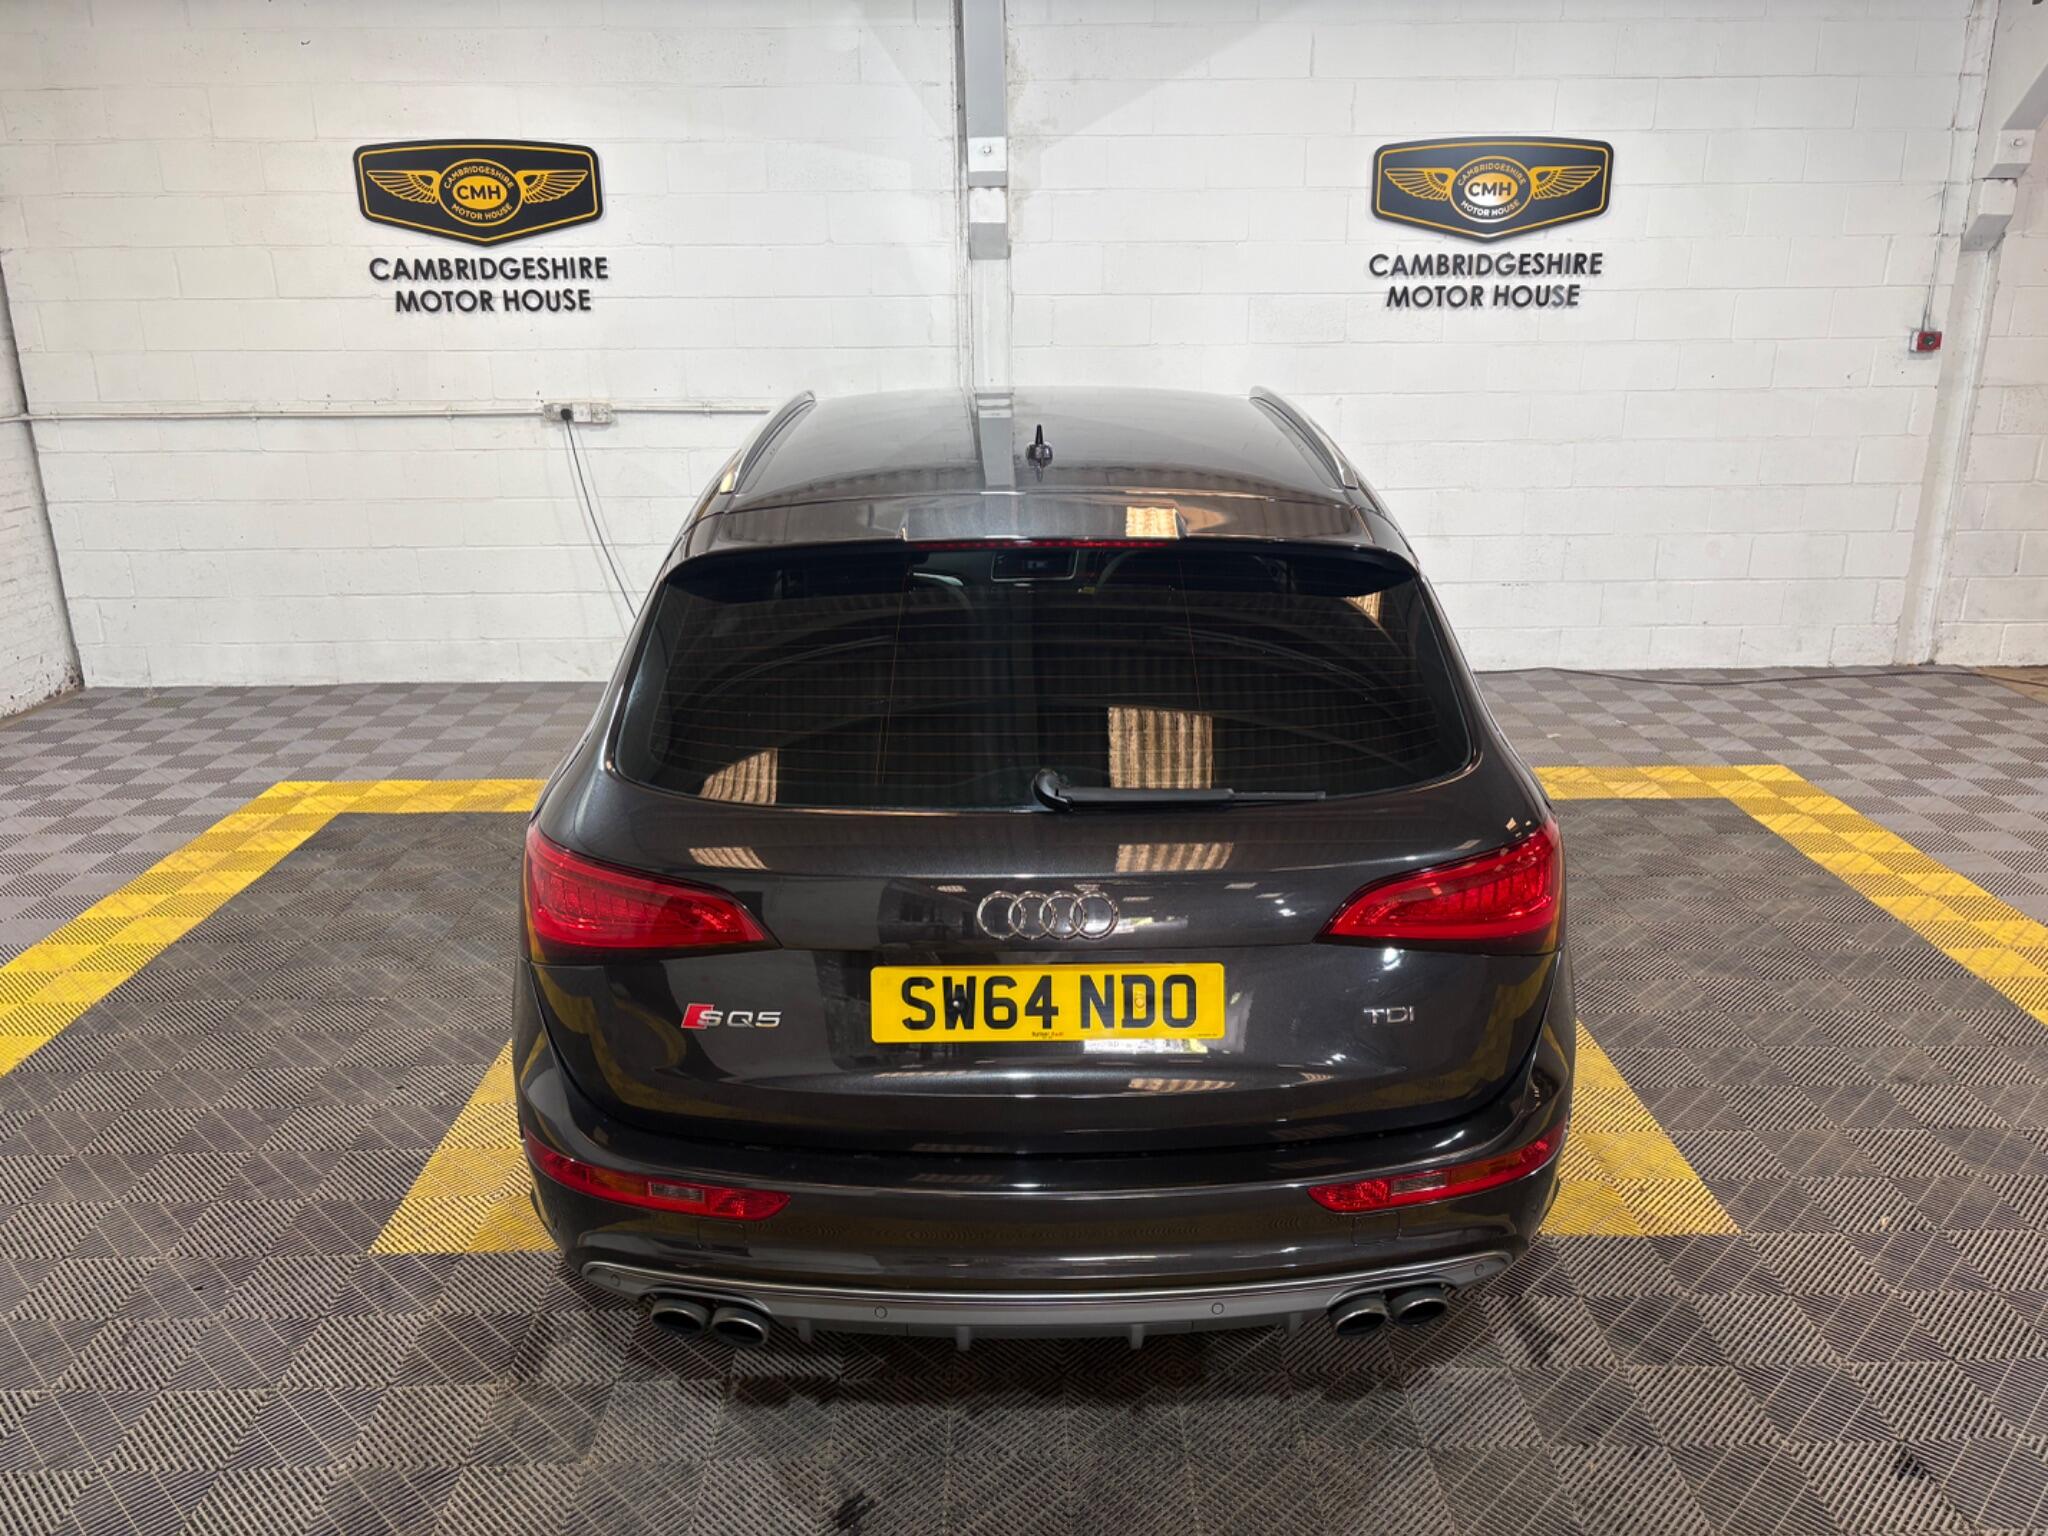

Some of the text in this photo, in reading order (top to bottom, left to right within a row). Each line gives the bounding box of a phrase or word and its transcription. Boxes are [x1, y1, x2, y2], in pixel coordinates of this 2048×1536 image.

[443, 165, 515, 190] CAMBRIDGESHIRE
[1457, 162, 1527, 187] CAMBRIDGESHIRE
[457, 184, 501, 201] CMH
[1468, 182, 1511, 198] CMH
[451, 203, 513, 220] MOTOR HOUSE
[1460, 199, 1520, 217] MOTOR HOUSE
[369, 257, 609, 281] CAMBRIDGESHIRE
[1369, 252, 1603, 277] CAMBRIDGESHIRE
[395, 289, 591, 312] MOTOR HOUSE
[1386, 284, 1581, 308] MOTOR HOUSE
[901, 974, 1197, 1030] SW64 NDO
[694, 1009, 782, 1028] SQ5
[1364, 1006, 1415, 1024] TDI
